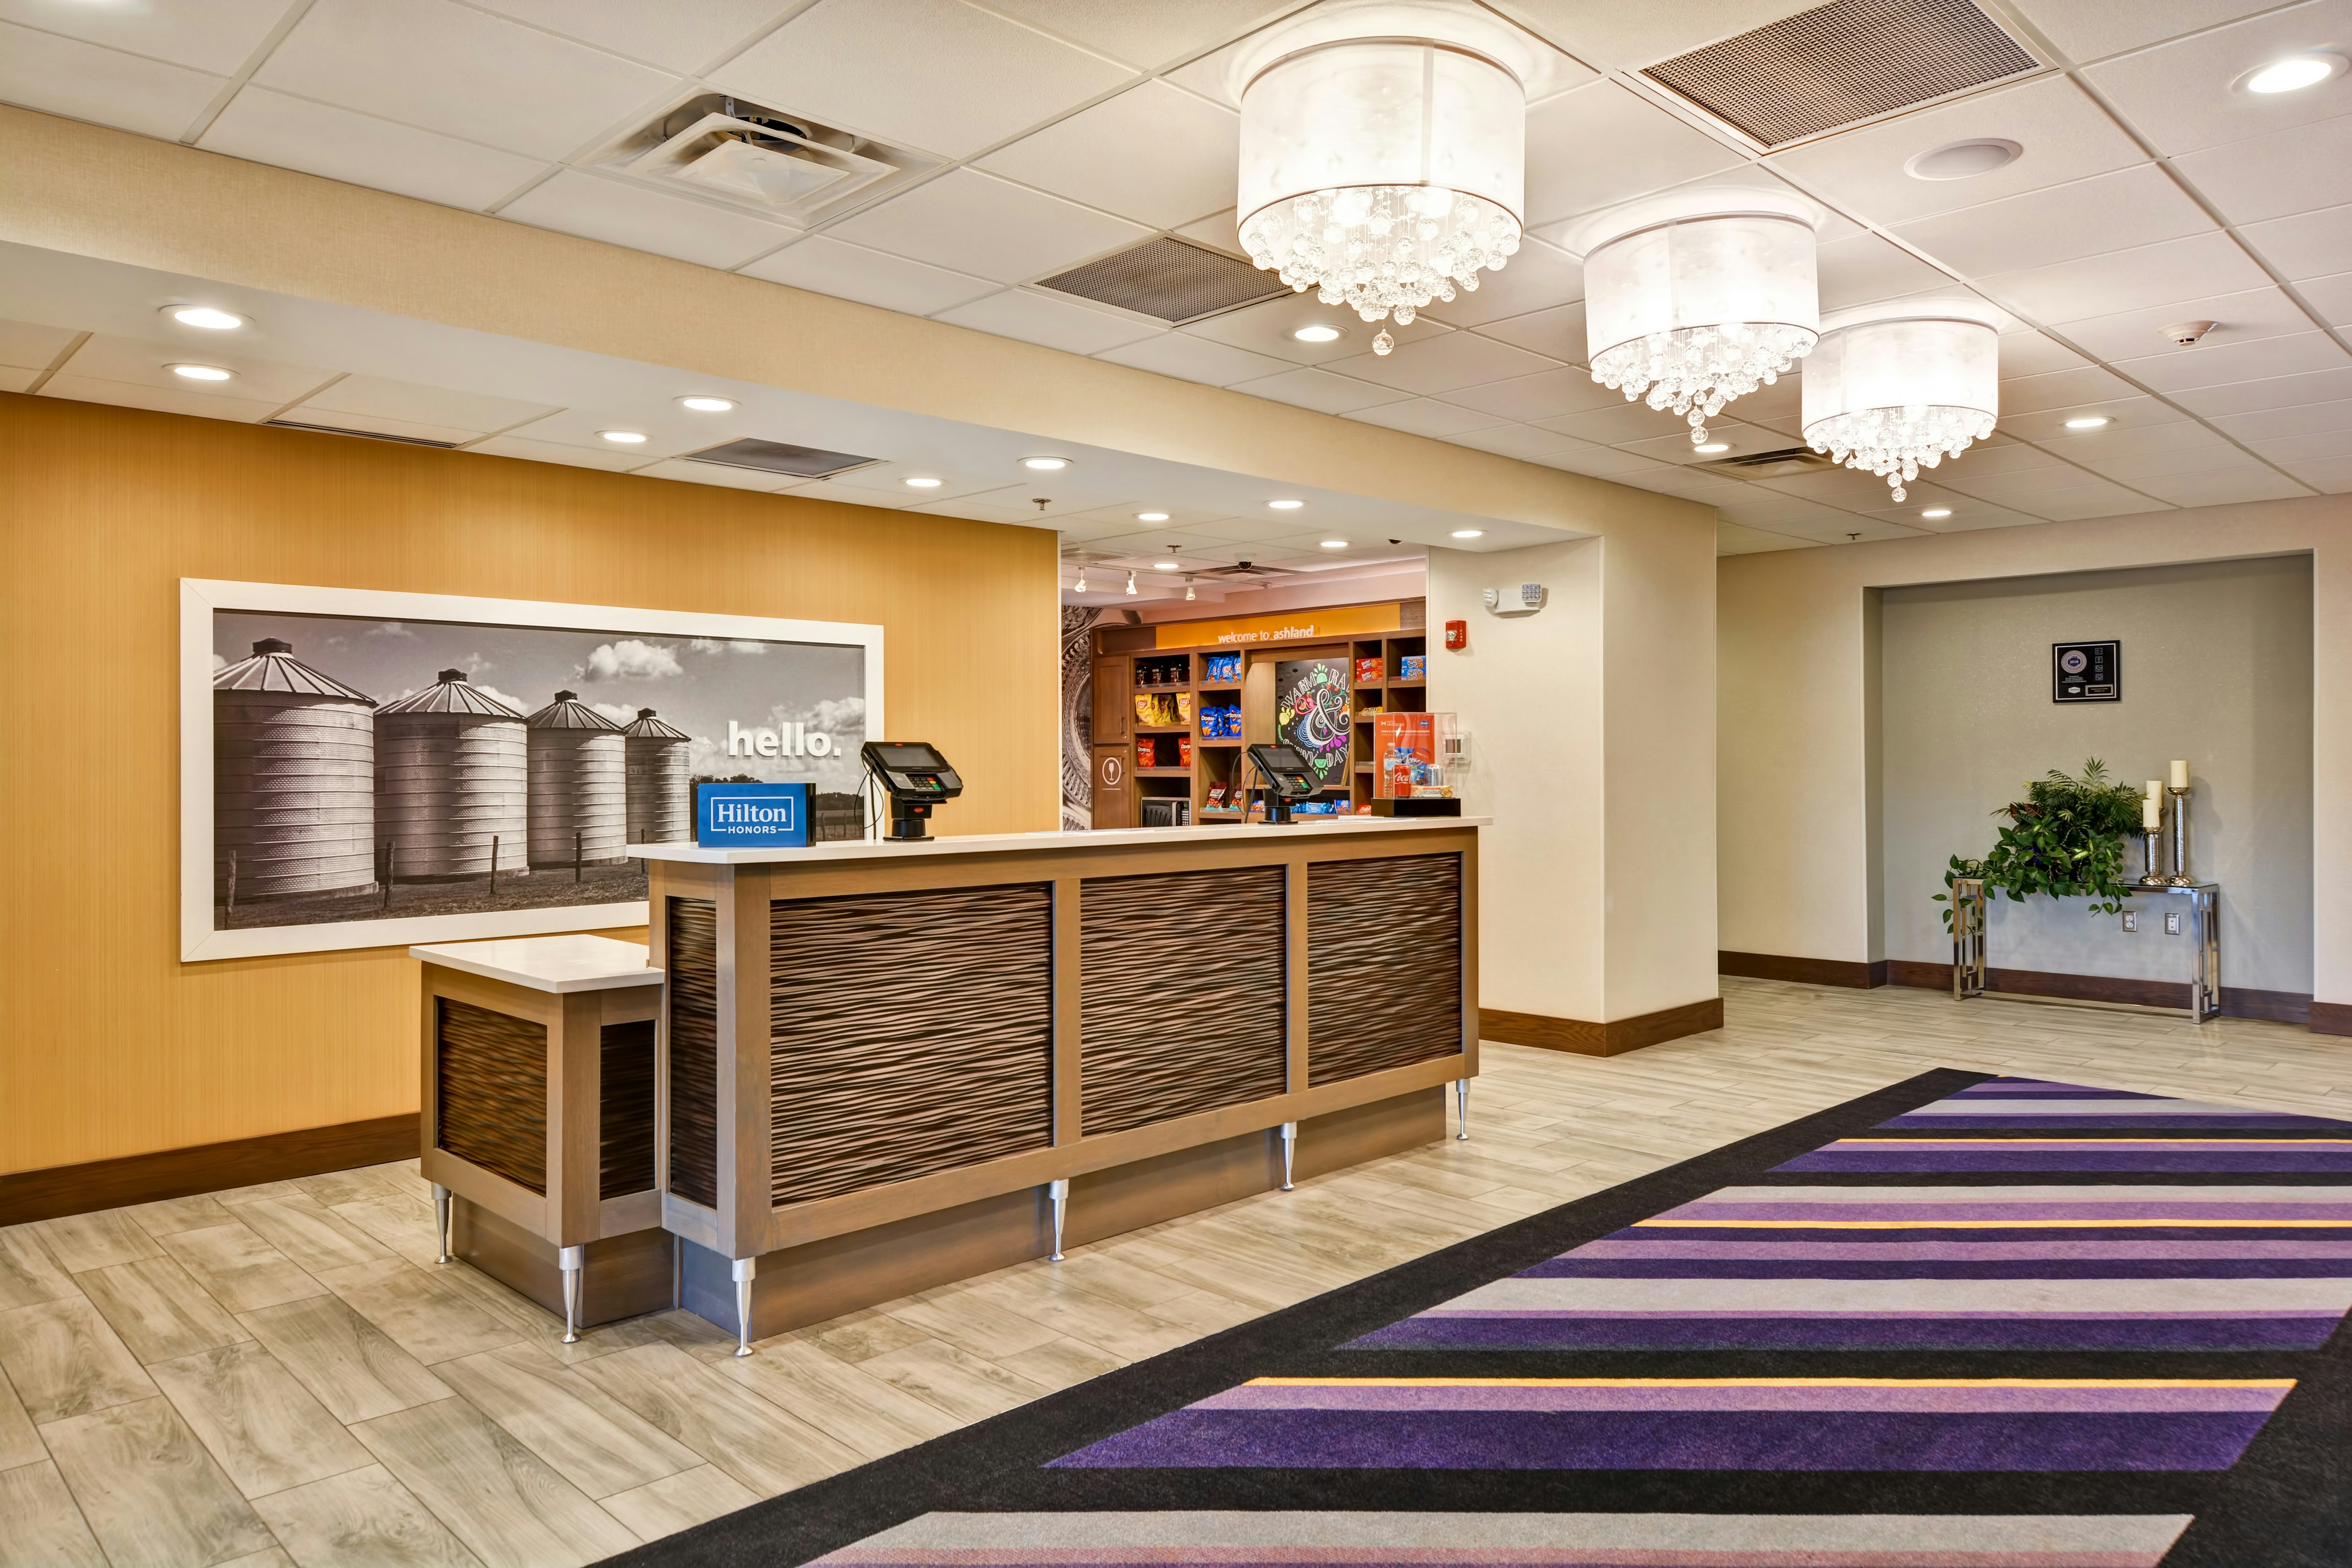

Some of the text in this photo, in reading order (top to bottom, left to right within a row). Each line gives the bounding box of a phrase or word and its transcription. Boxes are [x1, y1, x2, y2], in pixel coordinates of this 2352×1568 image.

[1218, 625, 1314, 644] welcome to ashland
[1280, 668, 1350, 710] WARM RA
[728, 720, 841, 757] hello.
[717, 804, 787, 822] Hilton
[728, 826, 777, 834] HONORS
